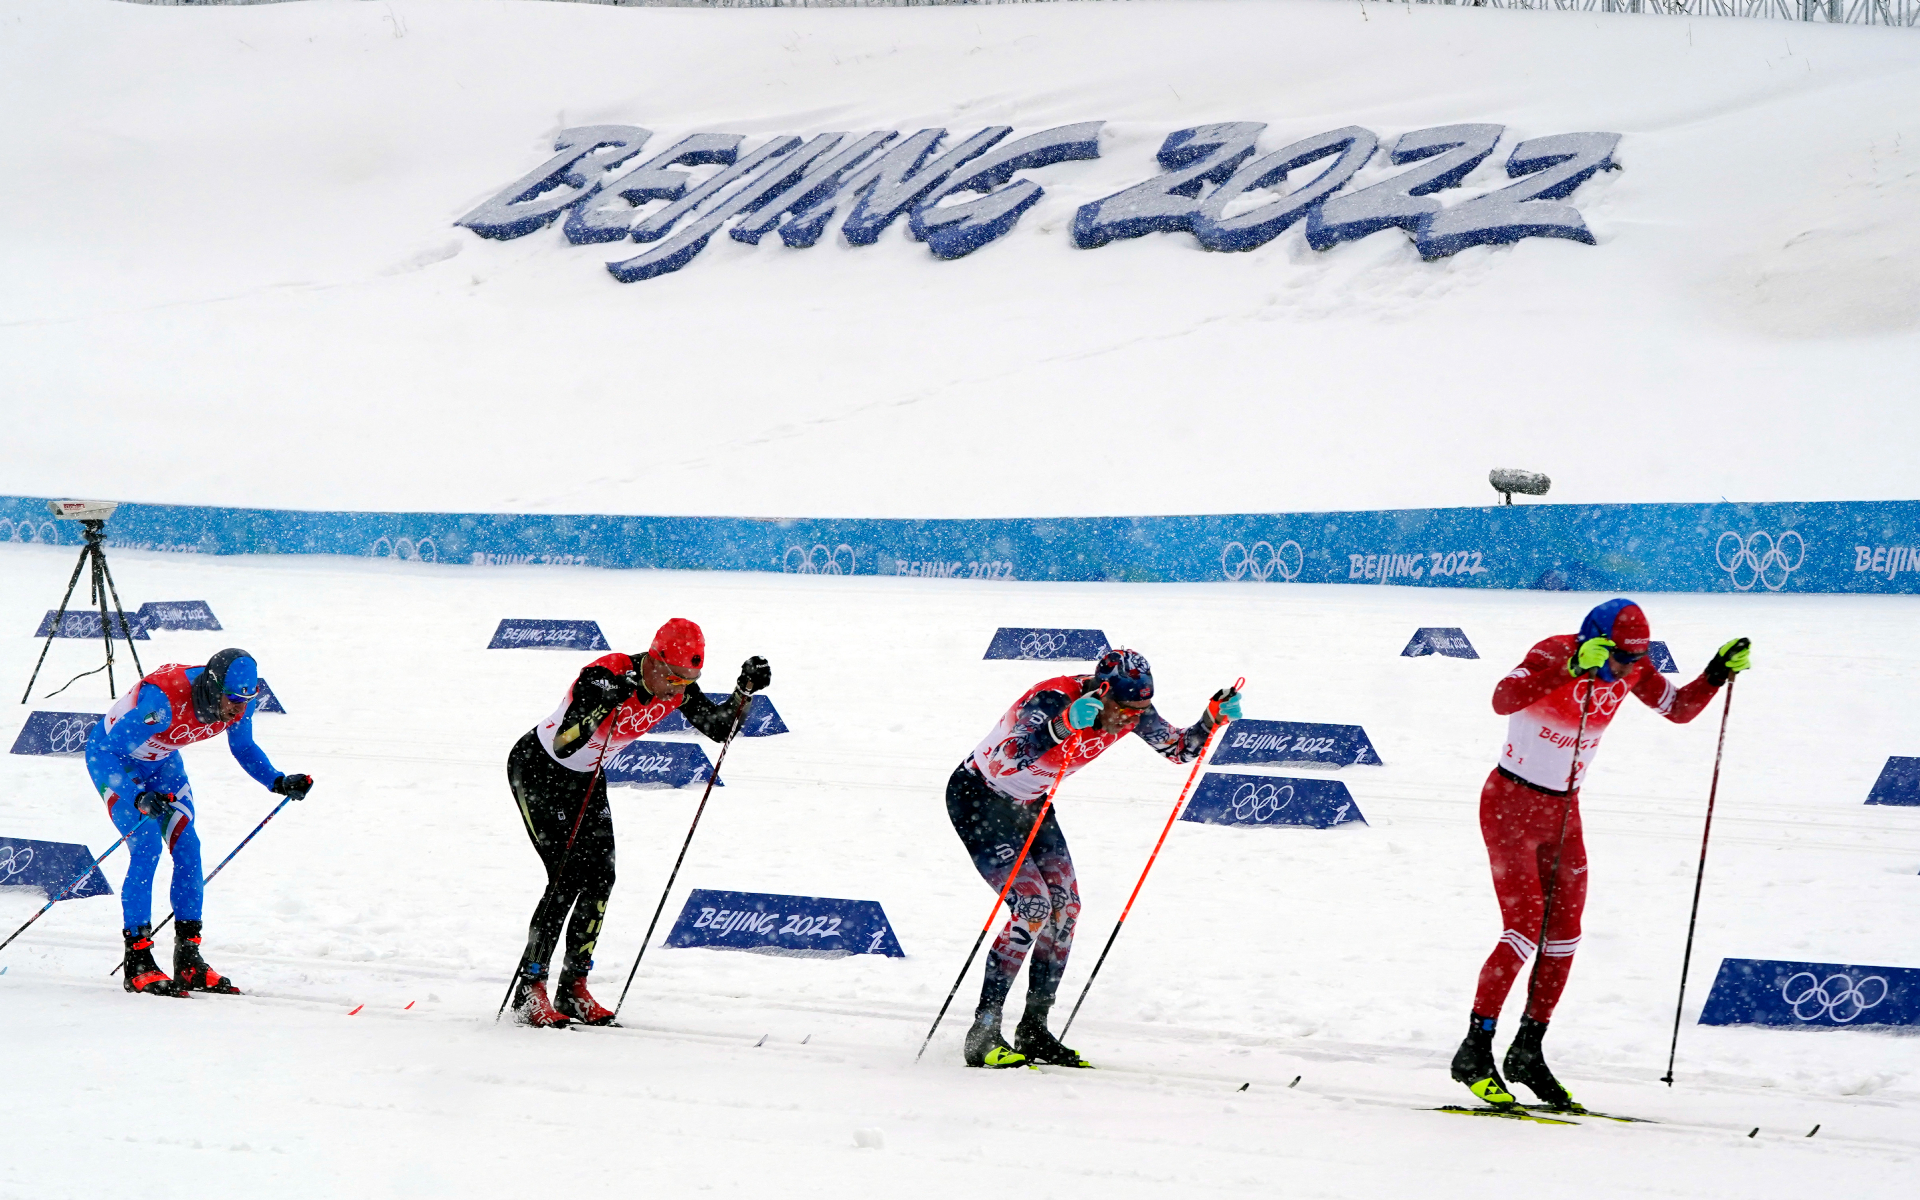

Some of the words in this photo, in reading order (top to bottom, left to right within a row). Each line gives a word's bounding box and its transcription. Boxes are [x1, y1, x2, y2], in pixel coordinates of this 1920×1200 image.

[453, 122, 1106, 283] BEIJING
[1073, 121, 1622, 261] 2022
[967, 560, 1017, 580] 2022
[1349, 553, 1423, 585] BEIJING
[1431, 551, 1488, 576] 2022
[1854, 546, 1920, 580] BEIJIN
[502, 627, 546, 644] BEIJING
[545, 629, 577, 641] 2022
[1231, 732, 1292, 754] BEIJING
[1290, 737, 1335, 753] 2022
[631, 754, 673, 773] 2022
[693, 907, 779, 937] BEIJING
[778, 914, 842, 938] 2022
